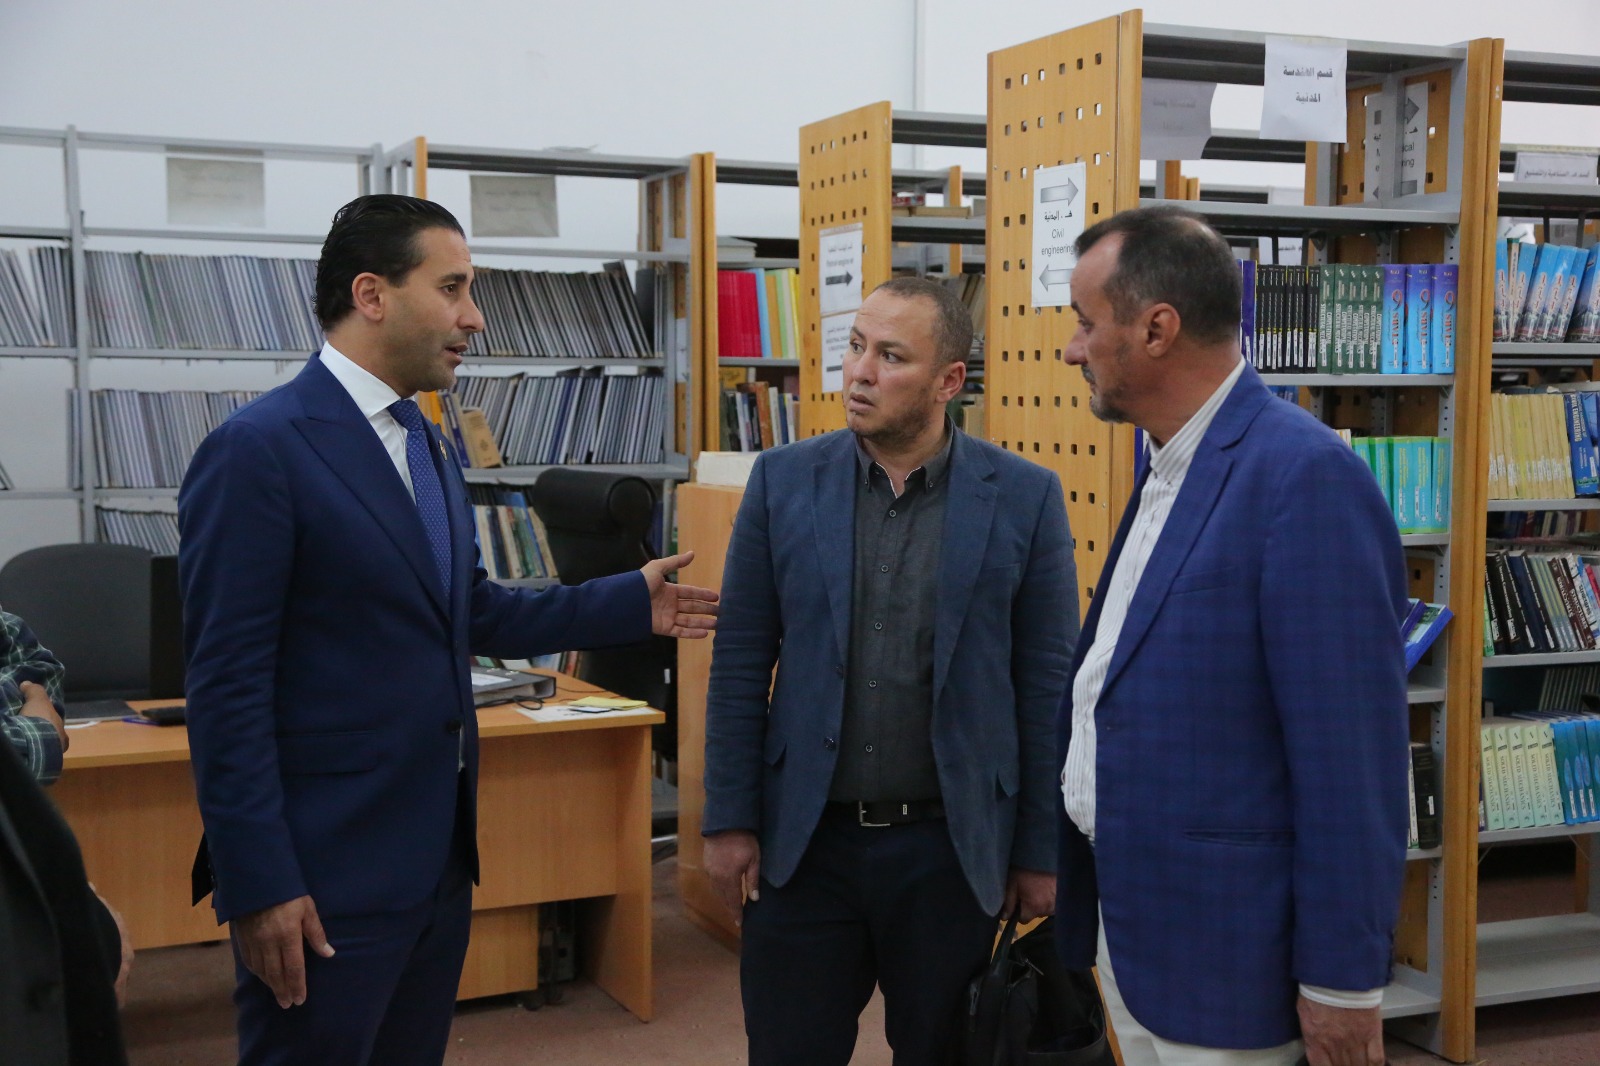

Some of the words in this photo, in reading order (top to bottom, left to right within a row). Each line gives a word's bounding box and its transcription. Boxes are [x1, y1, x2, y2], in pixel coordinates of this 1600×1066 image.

[1283, 65, 1315, 77] الهندسة
[1317, 68, 1333, 80] قسم
[1295, 91, 1321, 104] المدنية
[1043, 210, 1060, 222] المدنية
[1051, 228, 1065, 239] Civil
[1041, 244, 1075, 257] engineering
[1392, 289, 1403, 311] 9
[1420, 288, 1431, 311] 9
[1444, 290, 1456, 312] 9
[1572, 408, 1582, 442] ENGINEERING
